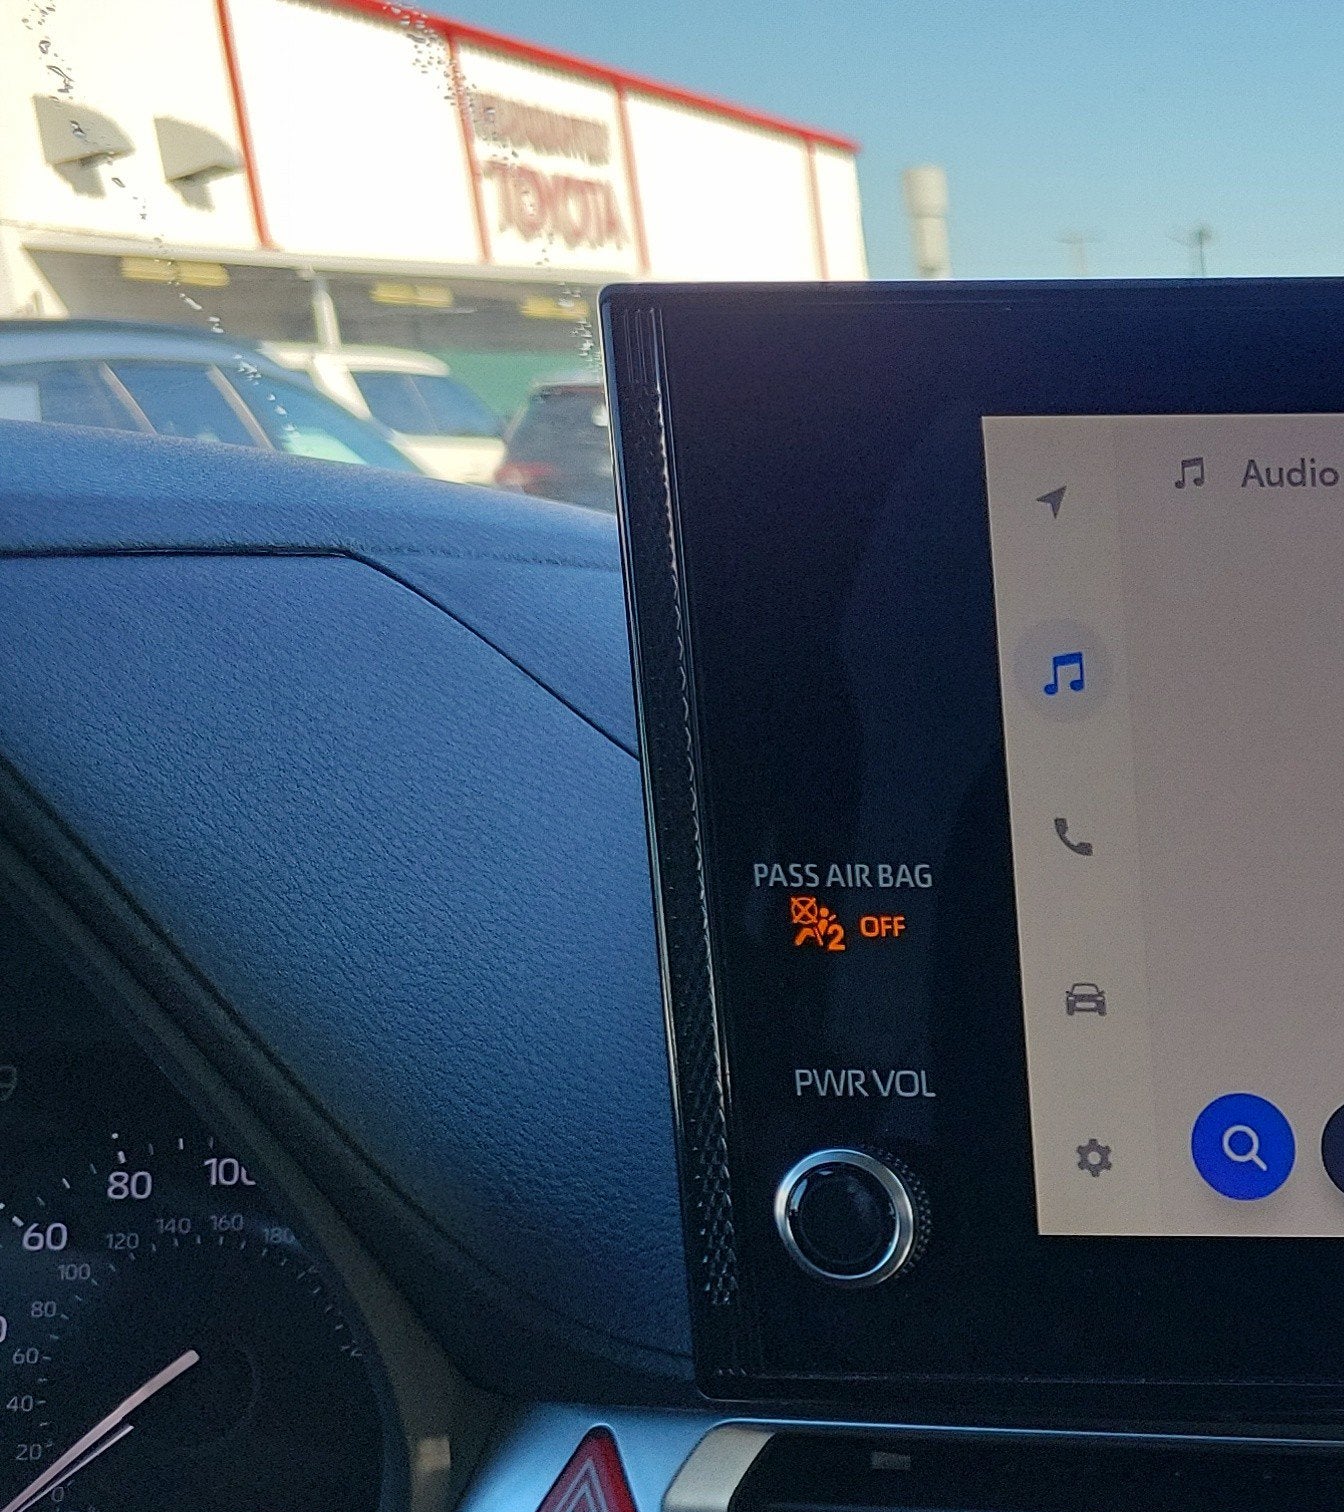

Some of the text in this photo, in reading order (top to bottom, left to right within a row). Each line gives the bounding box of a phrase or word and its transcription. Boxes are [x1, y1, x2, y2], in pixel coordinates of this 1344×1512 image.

[1240, 457, 1341, 488] Audio
[753, 863, 933, 888] PASS AIR BAG
[859, 916, 906, 938] OFF
[794, 1068, 936, 1098] PWR VOL
[106, 1170, 152, 1200] 80
[156, 1217, 192, 1235] 140
[209, 1214, 244, 1231] 160
[22, 1222, 68, 1251] 60
[106, 1232, 140, 1250] 120
[58, 1263, 91, 1281] 100
[30, 1301, 57, 1318] 80
[12, 1348, 39, 1364] 60
[6, 1395, 34, 1412] 40
[15, 1444, 42, 1462] 20
